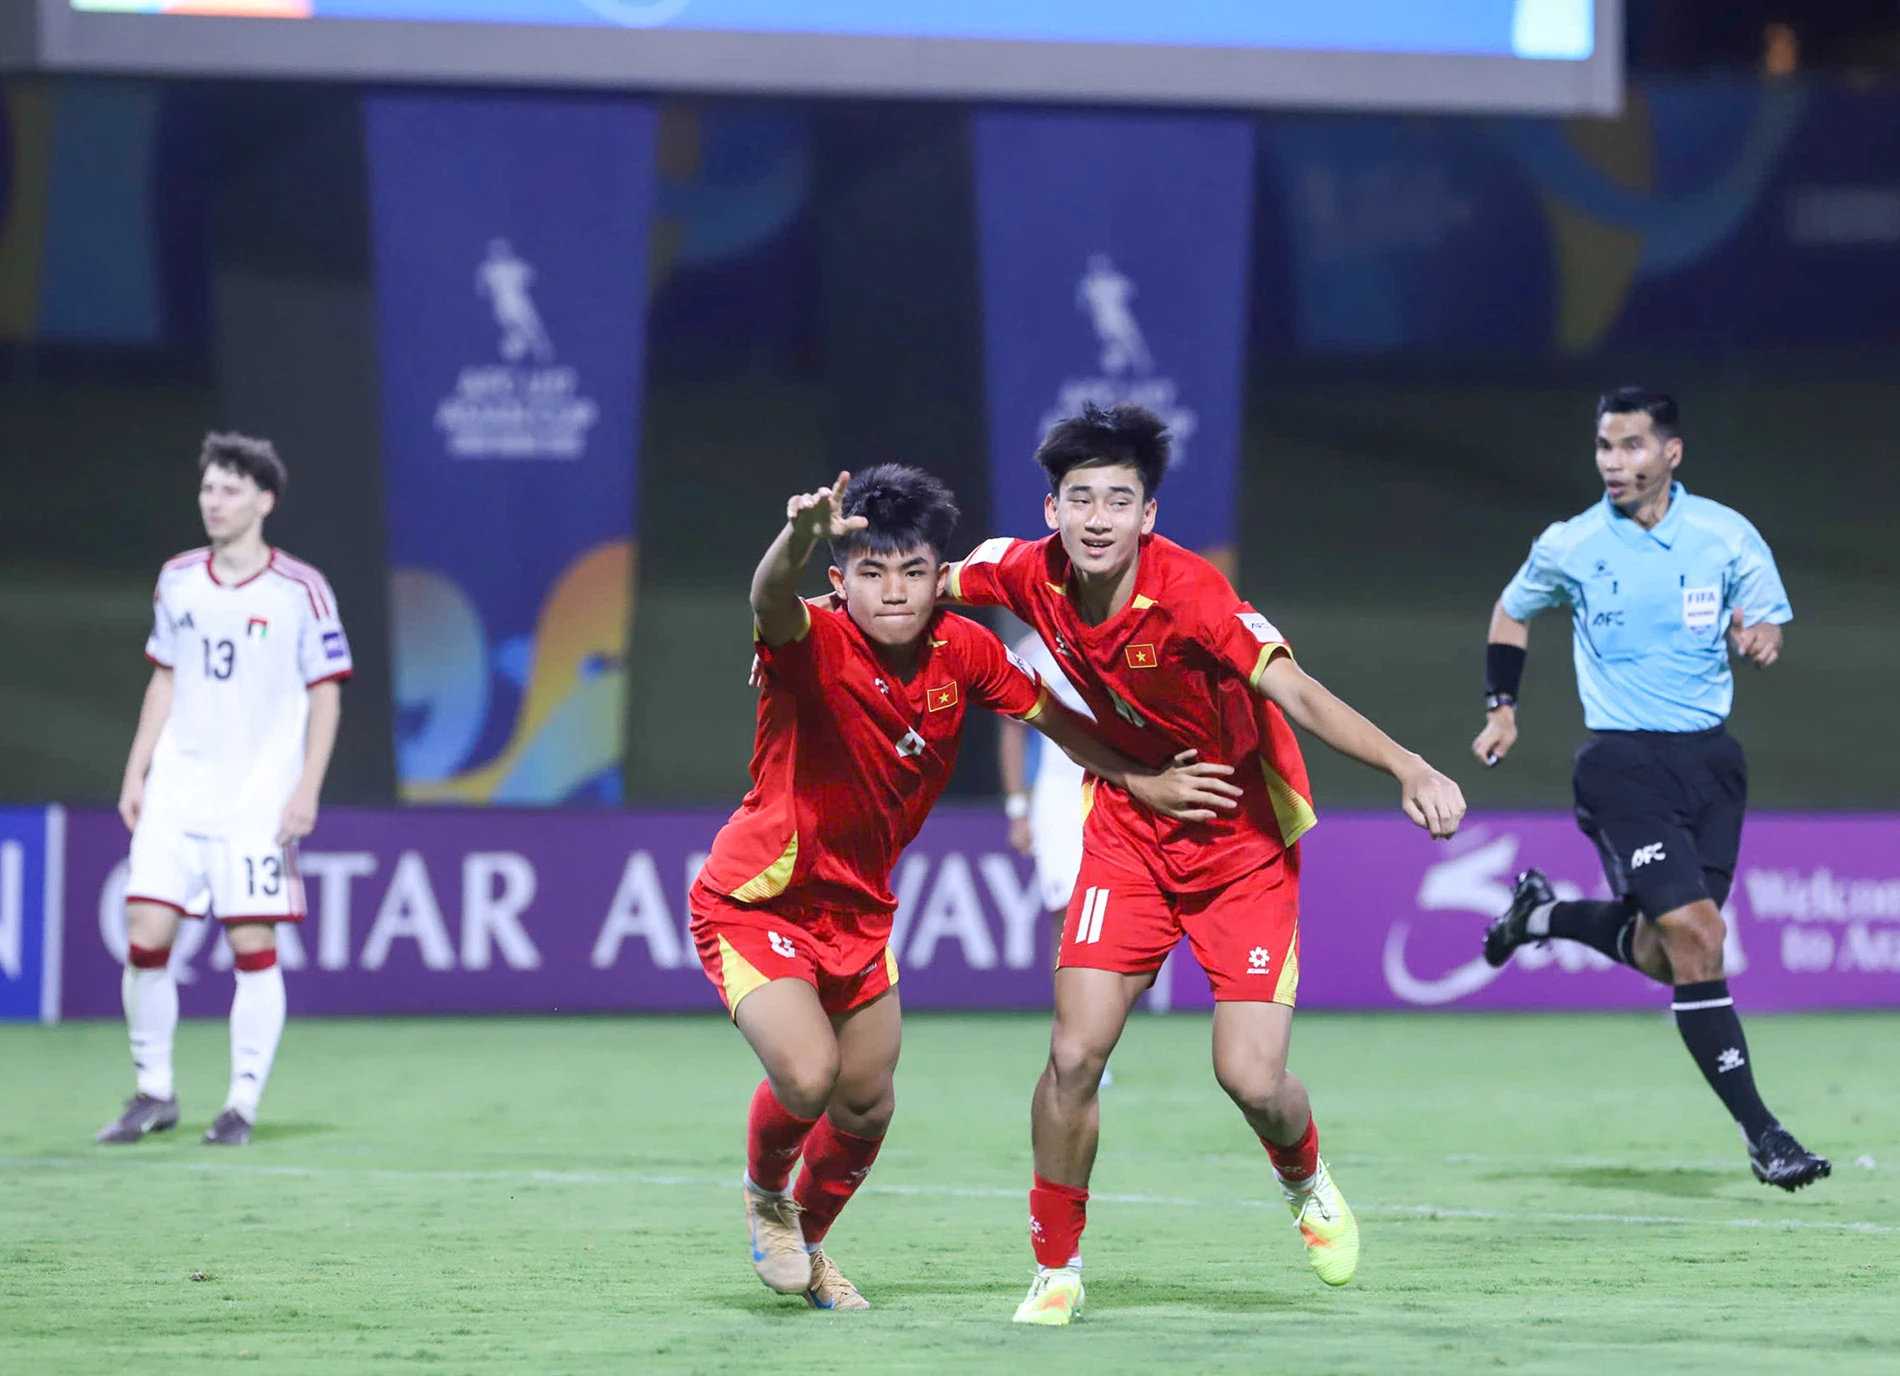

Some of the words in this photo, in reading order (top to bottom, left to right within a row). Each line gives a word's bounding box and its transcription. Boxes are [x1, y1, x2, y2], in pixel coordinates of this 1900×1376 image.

[1687, 591, 1716, 604] FIFA
[1592, 611, 1625, 627] AFC
[202, 637, 235, 680] 13
[1631, 841, 1667, 870] AFC
[244, 856, 282, 896] 13
[1075, 886, 1110, 944] 11
